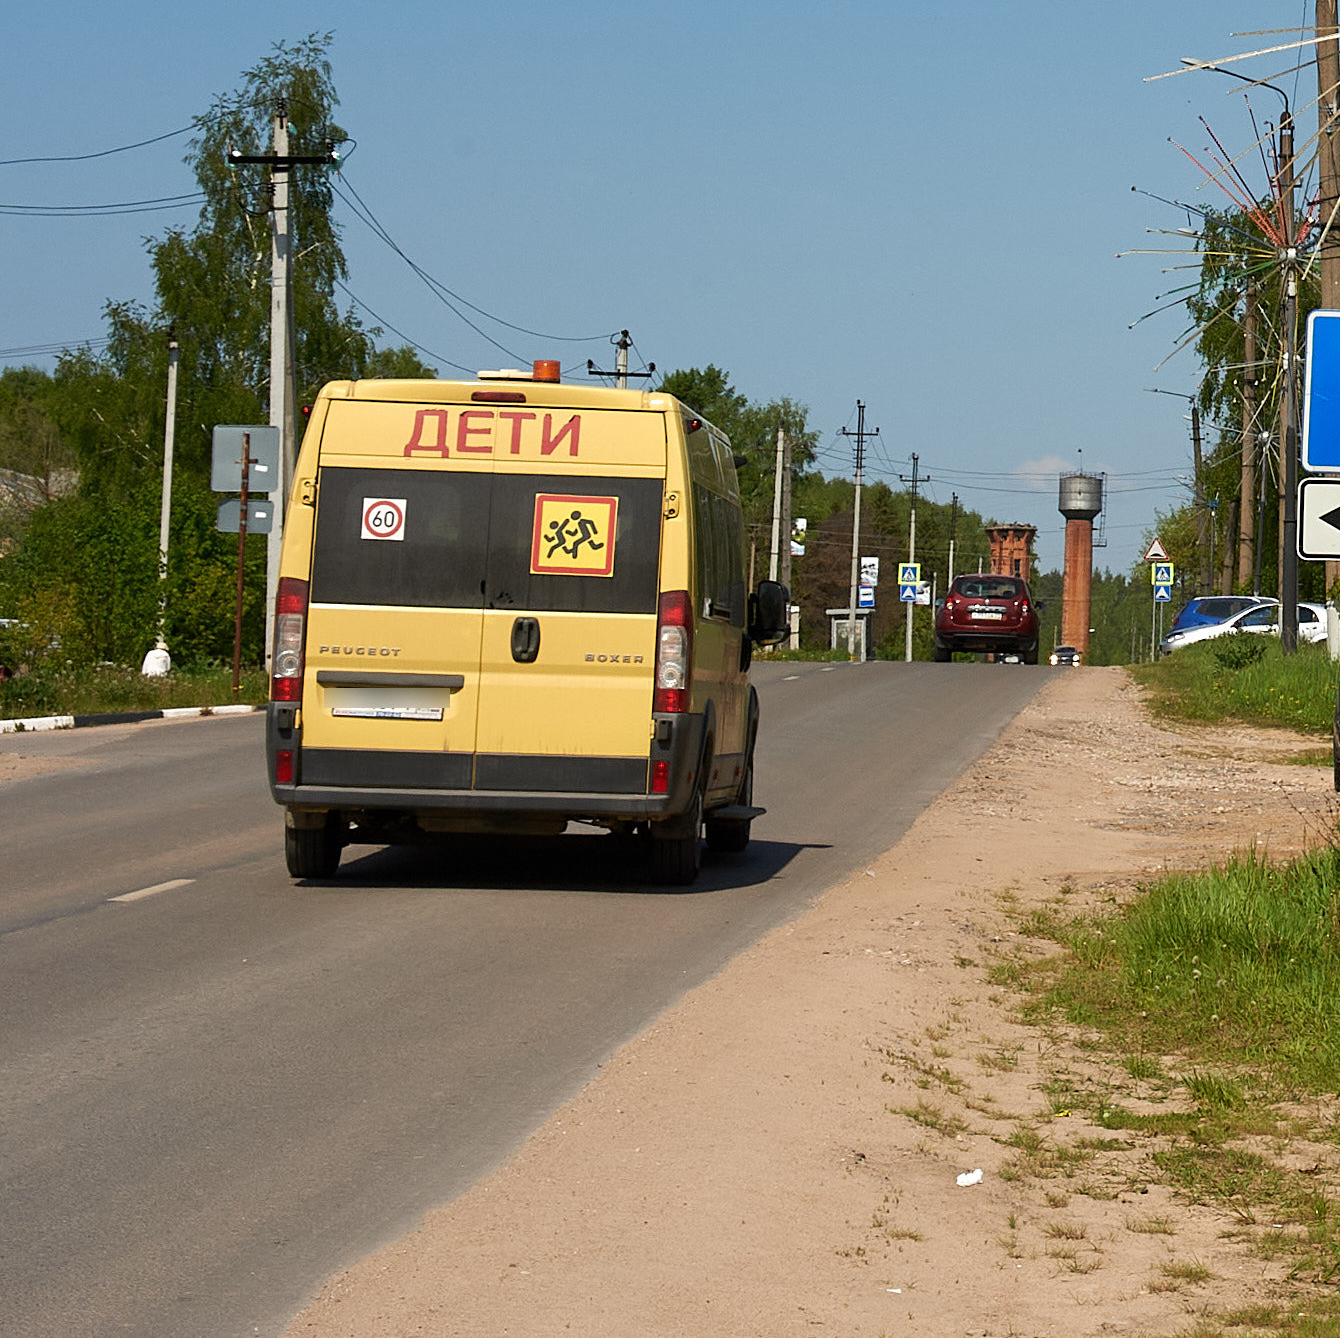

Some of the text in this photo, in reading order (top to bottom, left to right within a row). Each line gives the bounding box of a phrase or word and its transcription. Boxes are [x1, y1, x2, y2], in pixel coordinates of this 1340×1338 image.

[403, 409, 581, 458] ДЕТИ
[372, 510, 394, 528] 60
[319, 646, 401, 657] PEUGEOT
[584, 653, 644, 663] BOXER
